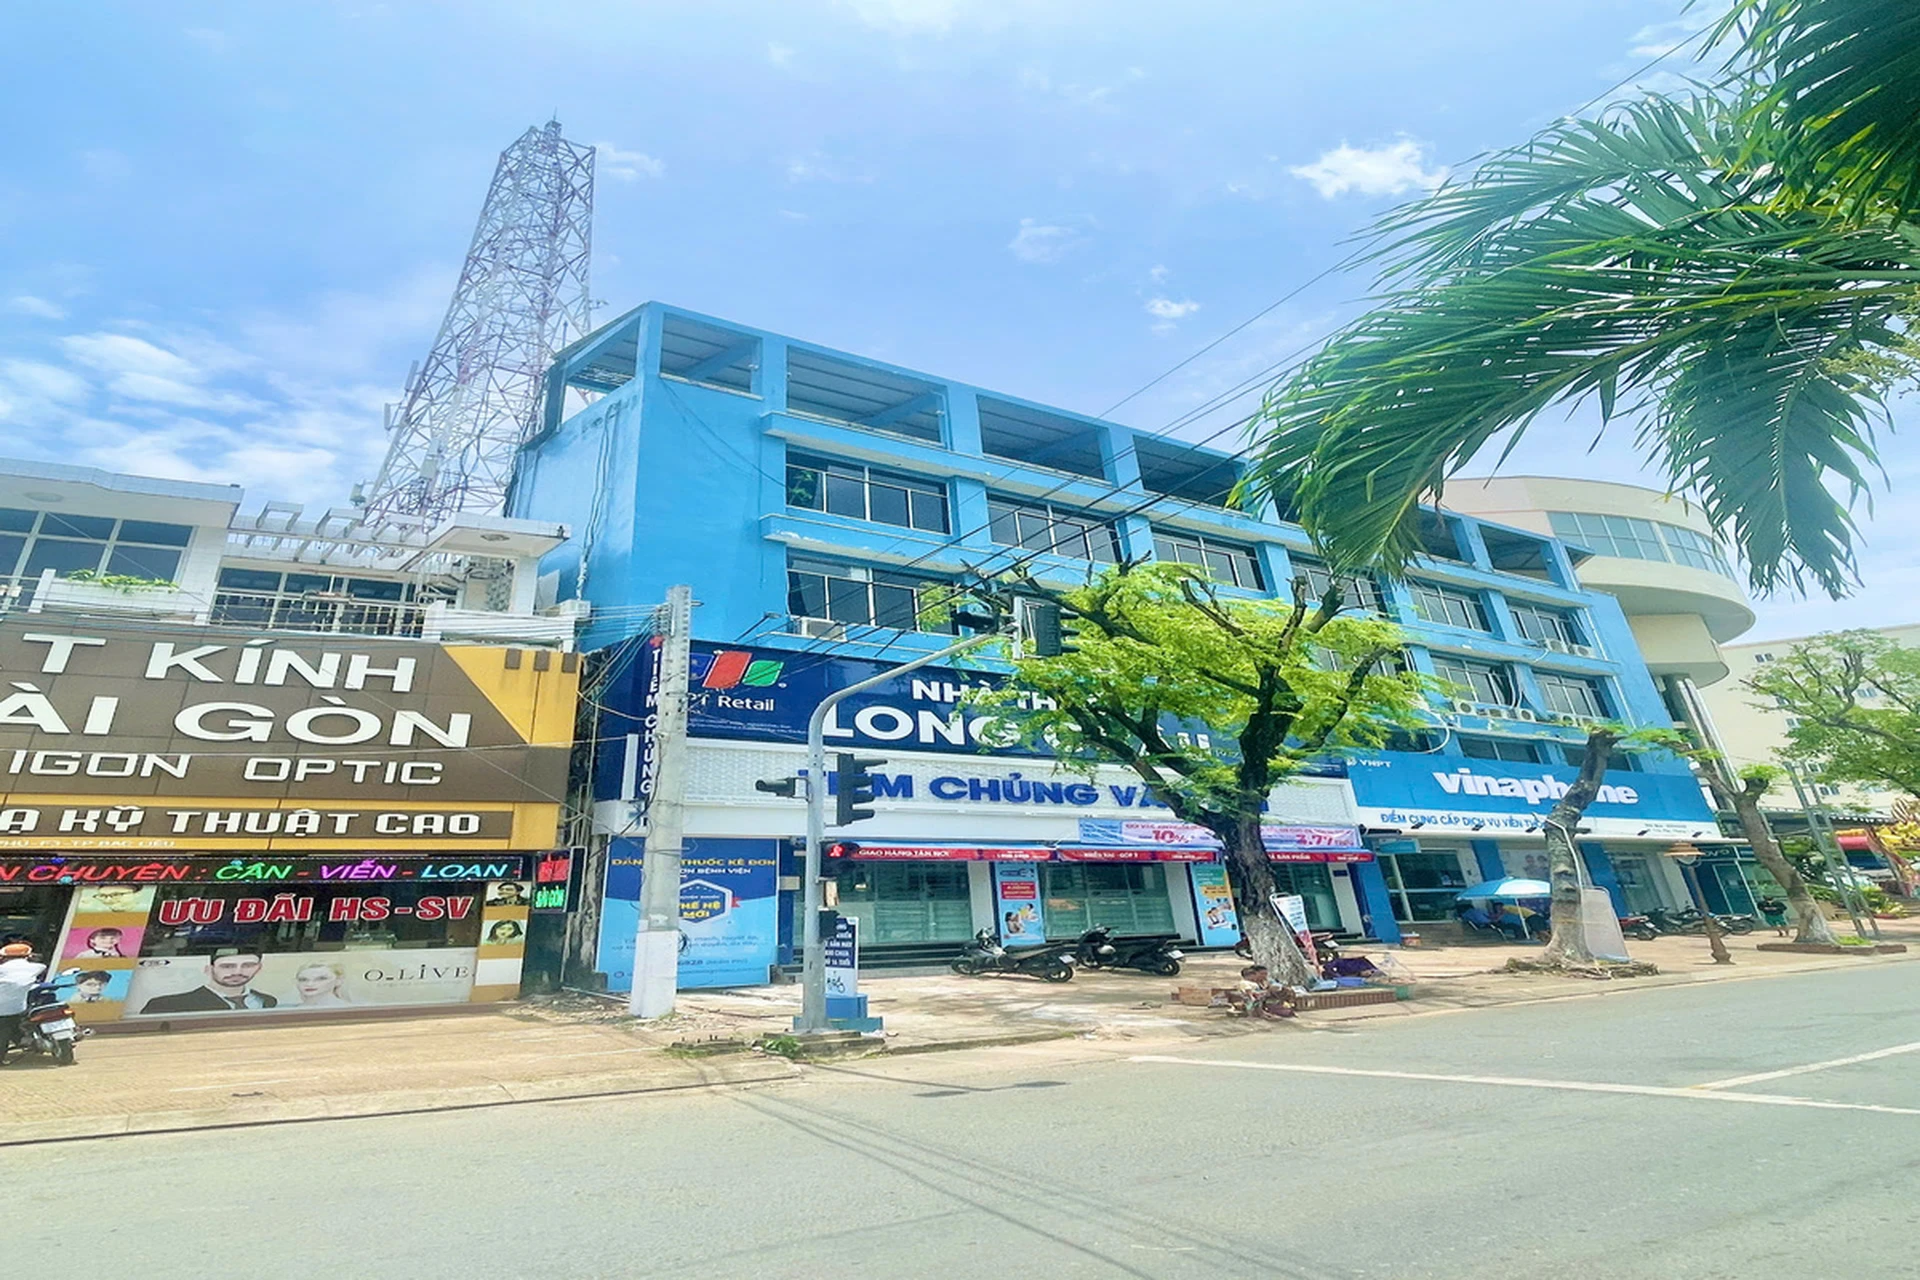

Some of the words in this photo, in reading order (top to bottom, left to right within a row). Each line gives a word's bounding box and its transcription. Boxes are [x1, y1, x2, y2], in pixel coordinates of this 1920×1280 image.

[0, 633, 107, 674] T
[145, 638, 416, 692] KÍNH
[718, 696, 774, 711] Retail
[174, 695, 471, 749] GÒN
[8, 750, 191, 779] IGON
[243, 757, 443, 785] OPTIC
[929, 772, 1099, 806] CHỦNG
[1433, 767, 1639, 804] vinaphne
[58, 805, 145, 833] KỸ
[166, 808, 359, 836] THUẬT
[375, 813, 480, 835] CAO
[1381, 810, 1407, 824] ĐIỂM
[28, 862, 191, 882] CHUYÊN
[159, 897, 225, 926] ƯU
[234, 893, 314, 923] ĐÃI
[330, 896, 474, 921] HS-SV
